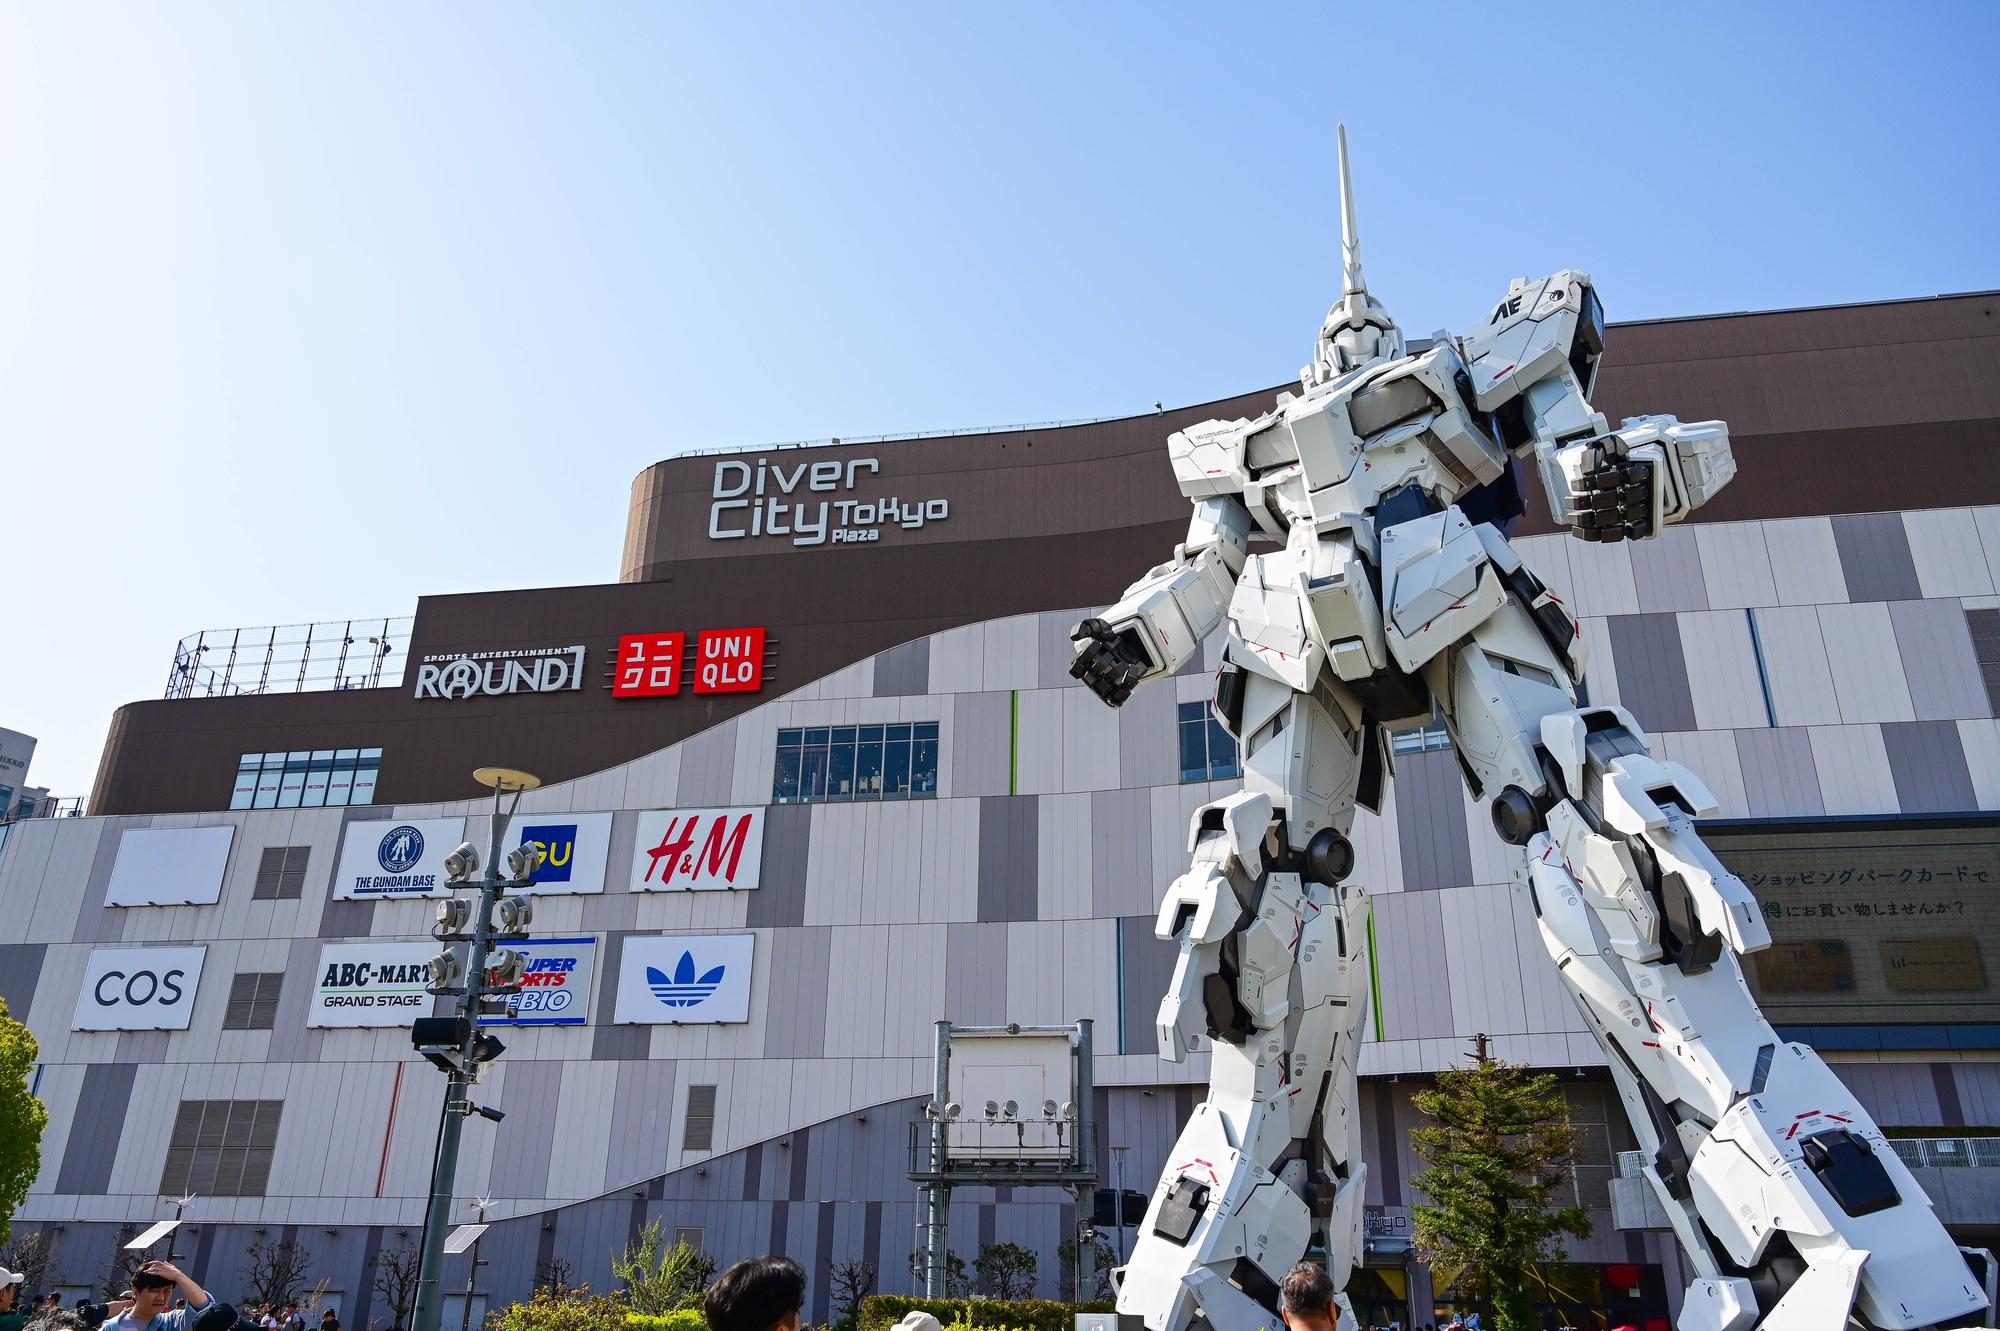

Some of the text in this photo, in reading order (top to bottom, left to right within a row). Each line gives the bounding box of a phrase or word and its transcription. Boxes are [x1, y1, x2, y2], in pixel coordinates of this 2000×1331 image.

[712, 458, 879, 499] Diver
[708, 496, 829, 546] City
[832, 529, 879, 544] Plaza
[424, 647, 569, 662] SPORTS ENTERTAINMENT
[626, 640, 673, 662] ユニ
[705, 636, 752, 658] UNI
[621, 666, 670, 688] クロ
[703, 661, 753, 688] QLO
[644, 813, 753, 885] H&M
[356, 875, 436, 888] THE GUNDAM BASE
[515, 951, 577, 972] UPER
[321, 962, 430, 988] ABC-MART
[94, 970, 185, 1006] COS
[324, 994, 423, 1008] GRAND STAGE
[490, 990, 573, 1012] EBIO
